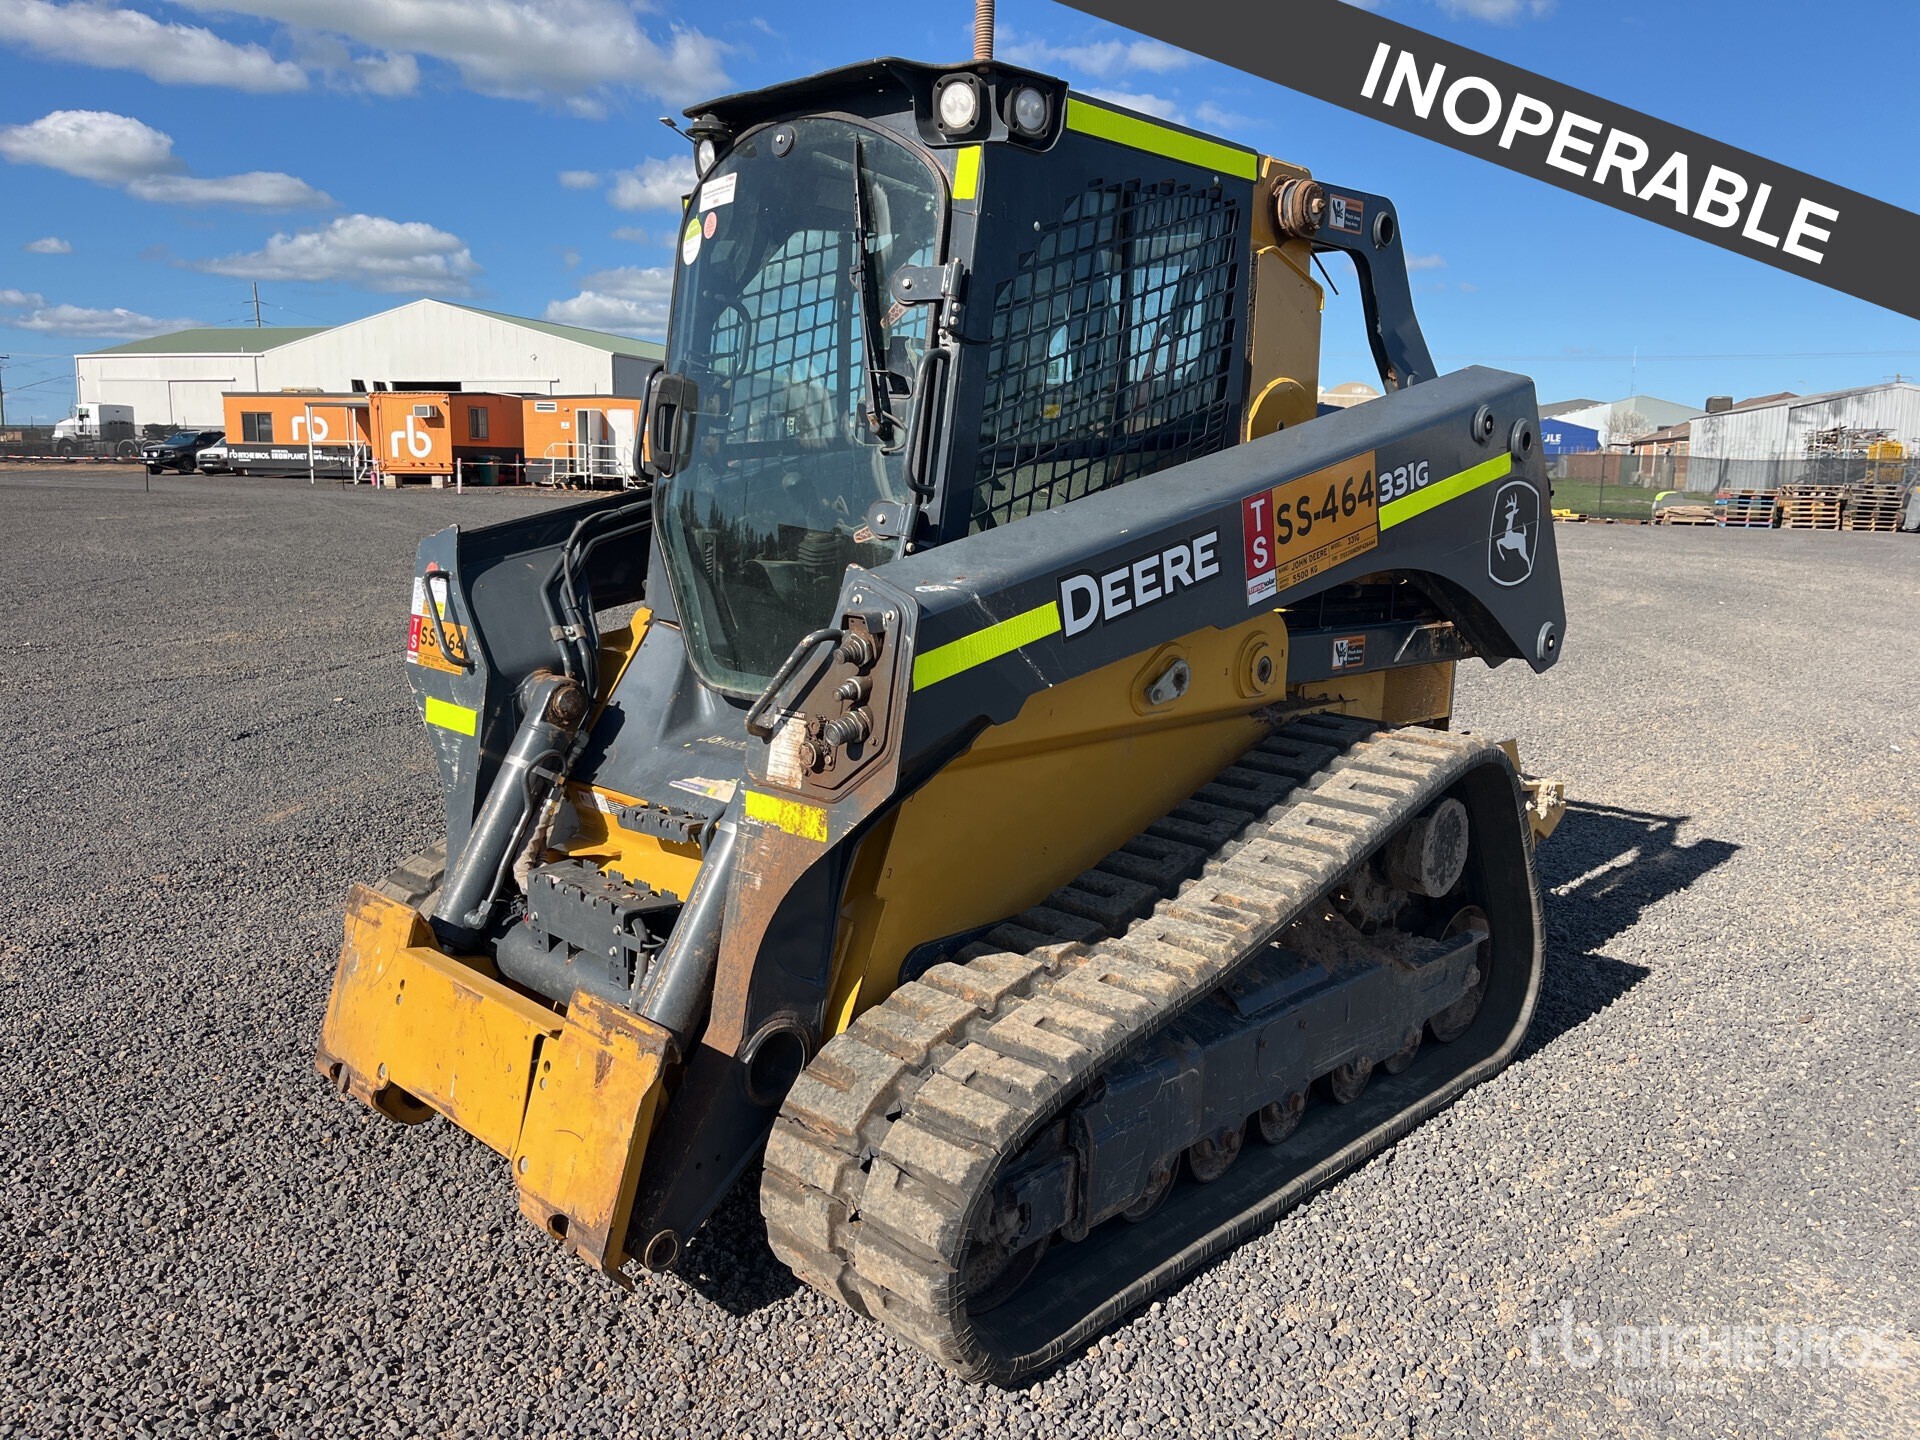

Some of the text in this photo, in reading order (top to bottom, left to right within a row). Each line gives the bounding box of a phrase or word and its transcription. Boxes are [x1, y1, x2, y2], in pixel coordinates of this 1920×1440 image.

[390, 414, 433, 459] rb
[1544, 433, 1562, 443] JLE
[1379, 461, 1429, 503] 331G
[1276, 469, 1375, 545] SS-464
[1291, 557, 1308, 571] JOHN
[1308, 548, 1328, 563] DEERE
[1292, 569, 1309, 583] 5500
[1310, 565, 1319, 574] KG
[1060, 530, 1220, 638] DEERE
[420, 626, 466, 654] SS-64
